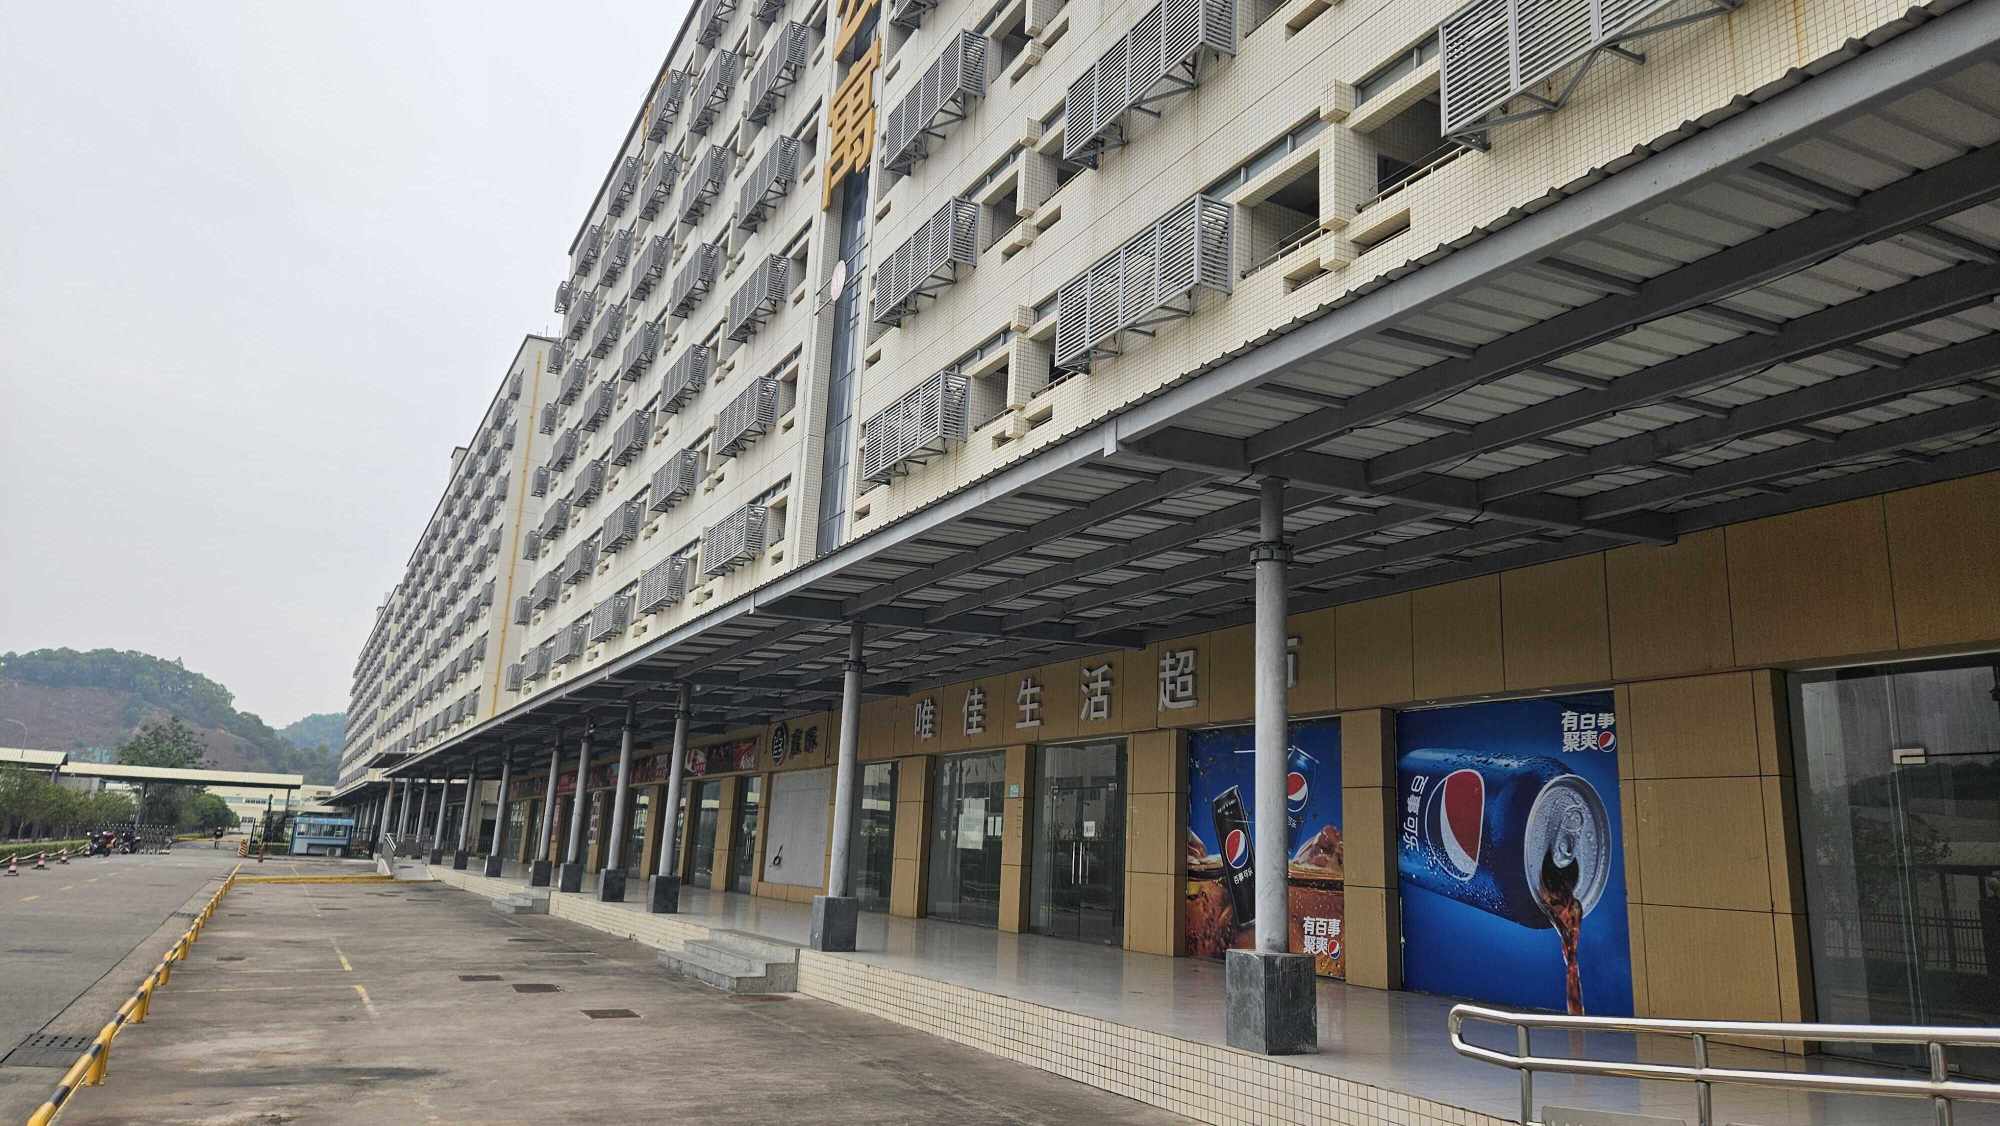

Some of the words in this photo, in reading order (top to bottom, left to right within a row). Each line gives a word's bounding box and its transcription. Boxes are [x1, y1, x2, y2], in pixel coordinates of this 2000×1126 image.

[1562, 730, 1598, 753] 聚爽
[1403, 775, 1429, 852] 百事可乐
[1303, 915, 1342, 938] 有百事
[1303, 935, 1328, 955] 聚爽
